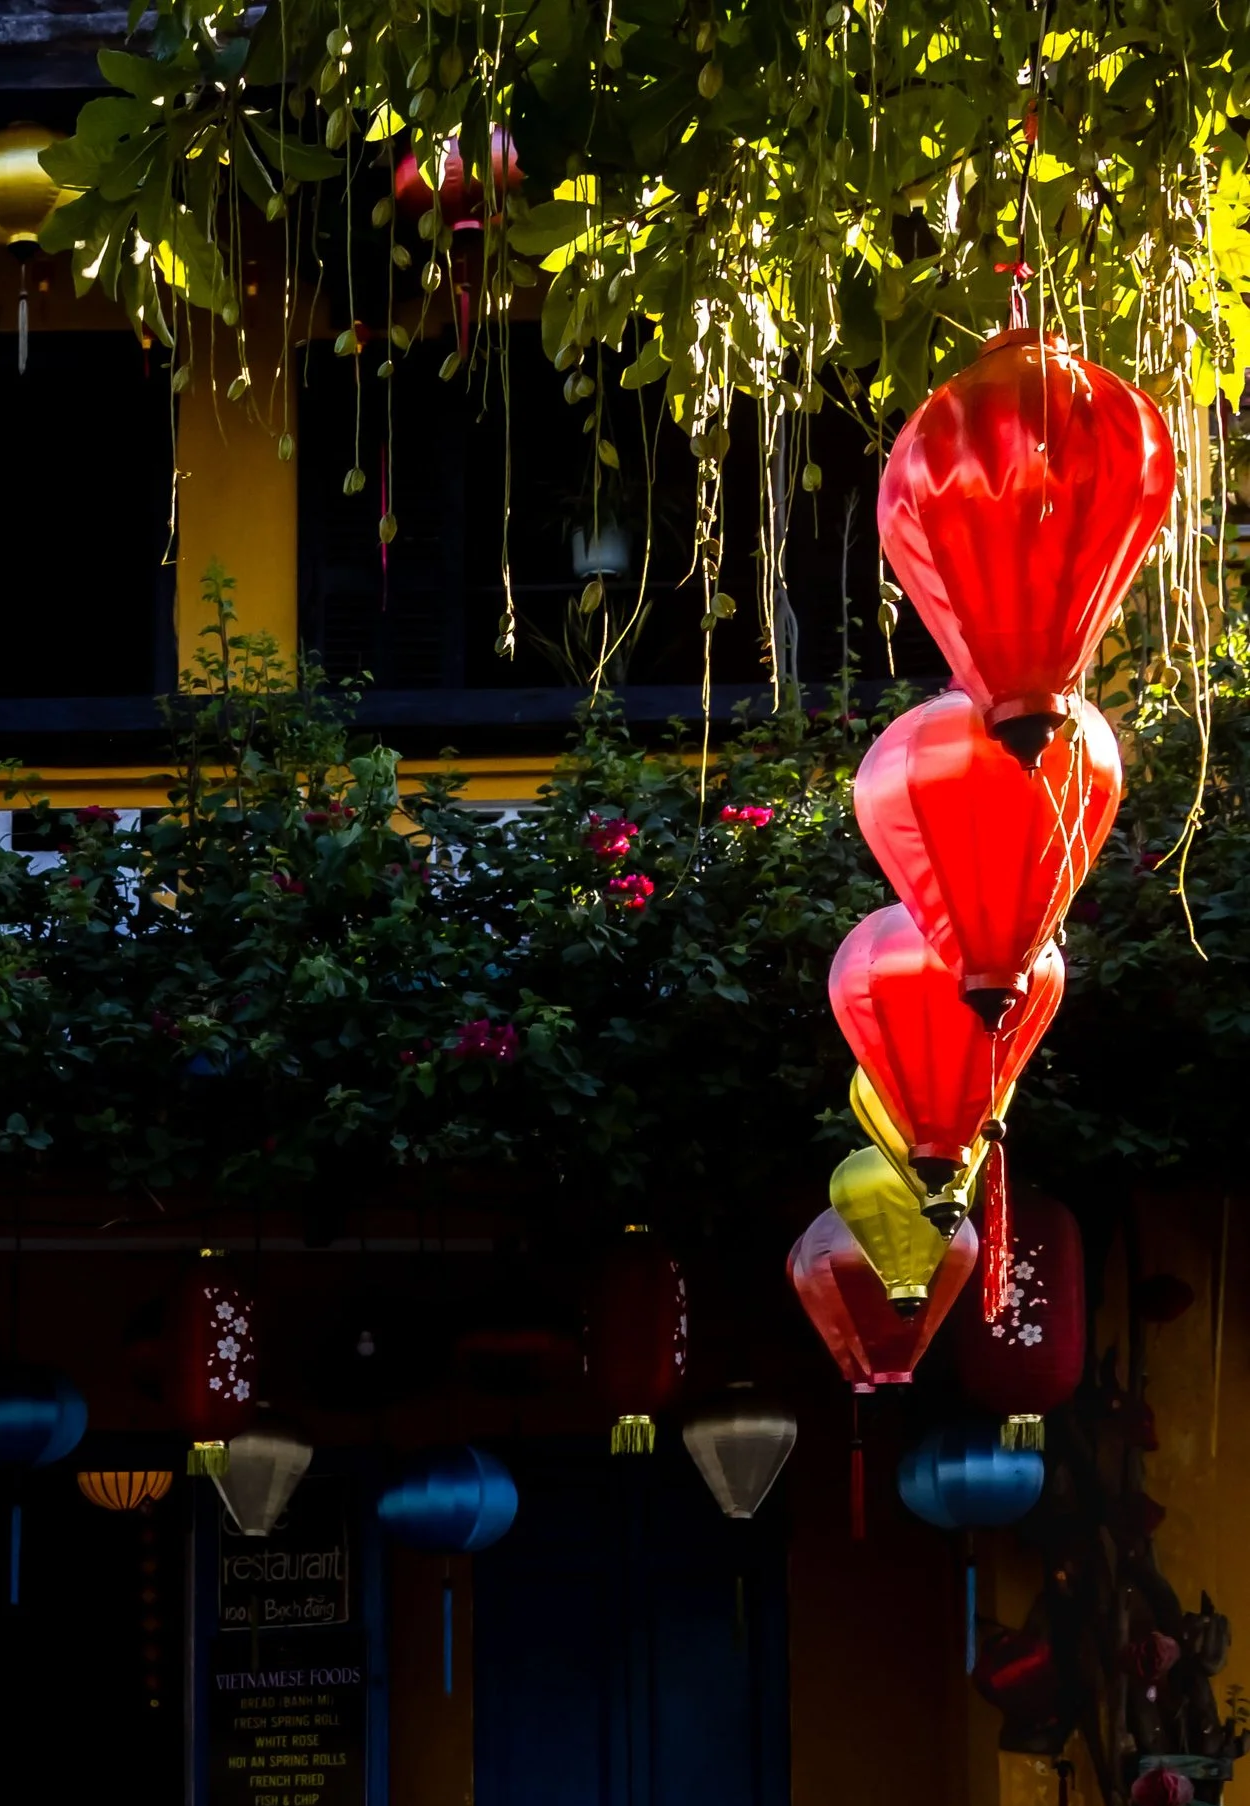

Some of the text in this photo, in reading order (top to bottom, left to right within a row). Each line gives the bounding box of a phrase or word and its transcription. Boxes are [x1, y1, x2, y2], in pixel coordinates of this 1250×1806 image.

[223, 1545, 344, 1585] restaurant
[215, 1667, 361, 1690] VIETNAMESE FOODS
[240, 1697, 275, 1710] BREAD
[234, 1714, 341, 1731] FRESH SPRING ROLL
[255, 1734, 319, 1749] WHITE ROSE
[251, 1755, 265, 1768] AN
[269, 1754, 309, 1768] SPRING
[313, 1753, 347, 1766] ROLLS
[250, 1773, 325, 1788] FRENCH FRIED
[255, 1793, 320, 1806] FISH & CHIP
